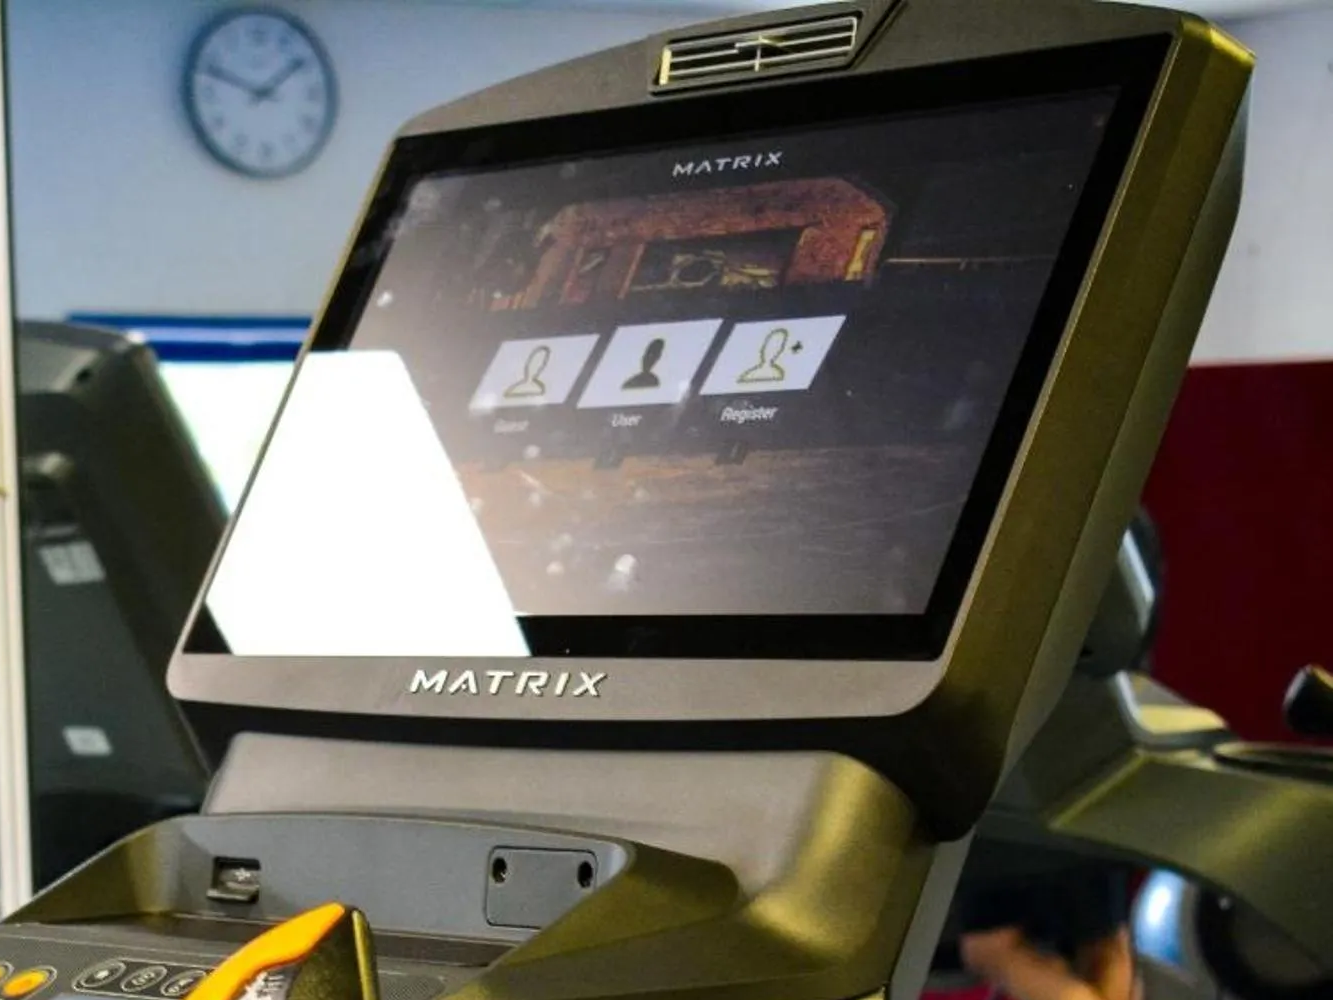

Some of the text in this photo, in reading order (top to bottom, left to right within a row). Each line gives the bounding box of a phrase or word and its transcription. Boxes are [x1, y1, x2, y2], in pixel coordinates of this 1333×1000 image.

[672, 151, 784, 177] MATRIX
[612, 412, 643, 428] User
[720, 405, 778, 424] Register
[409, 668, 608, 698] MATRIX
